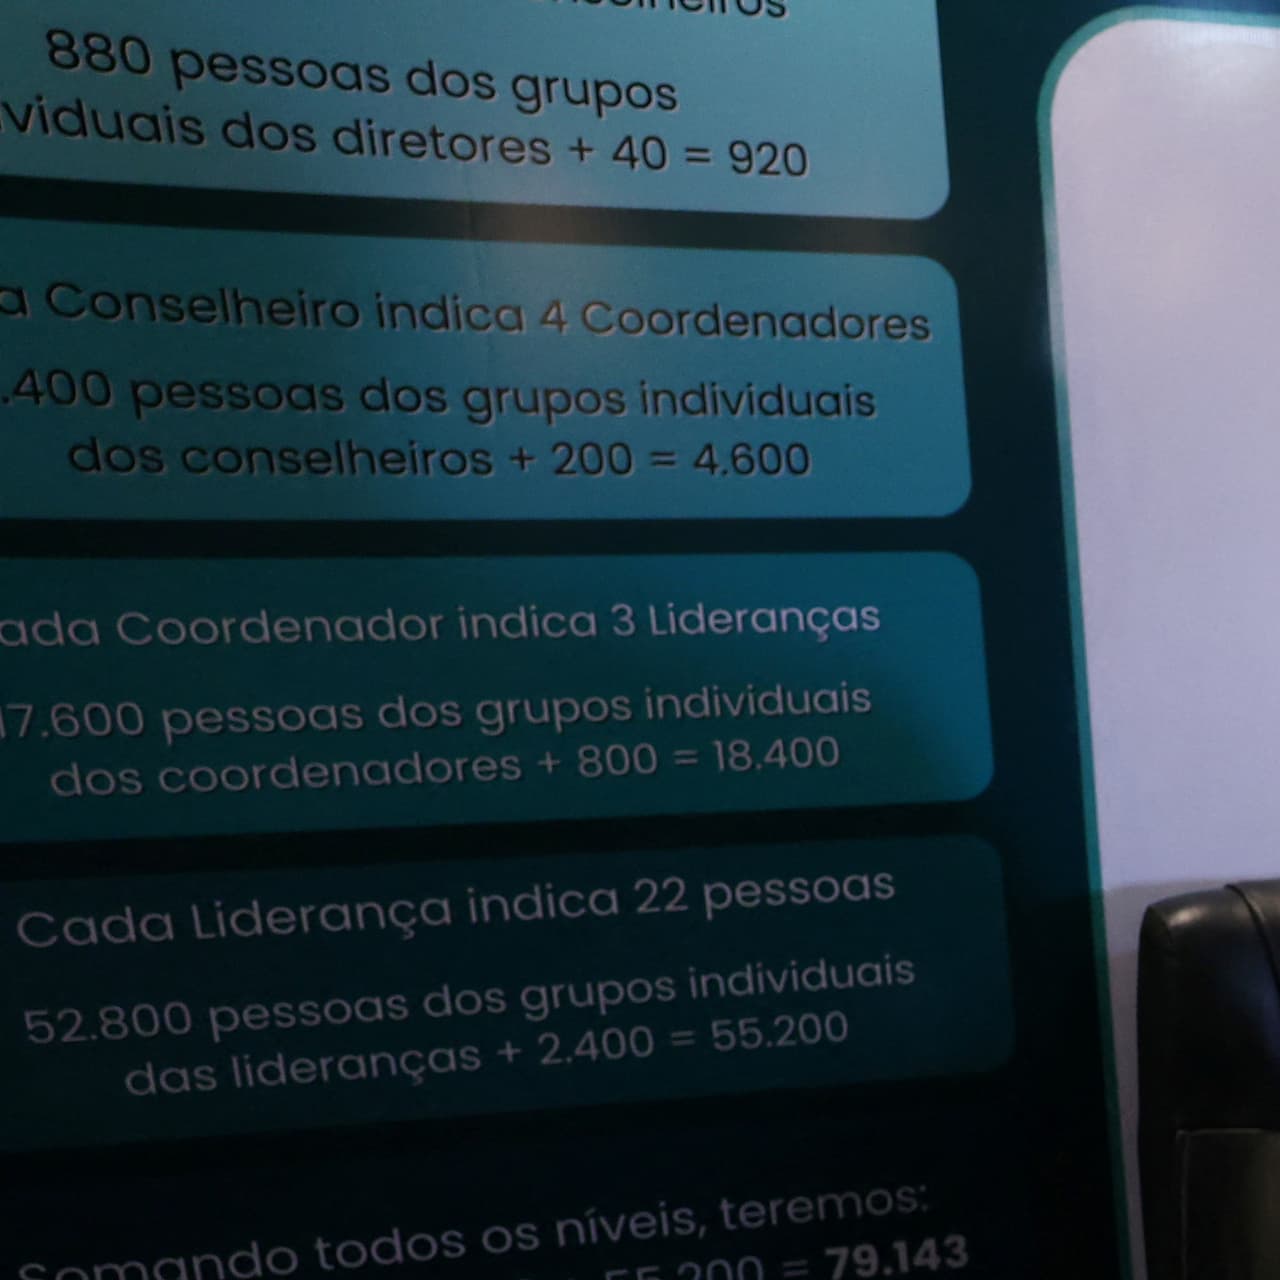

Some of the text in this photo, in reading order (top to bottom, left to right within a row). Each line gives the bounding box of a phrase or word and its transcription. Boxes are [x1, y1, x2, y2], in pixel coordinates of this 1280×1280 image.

[46, 28, 679, 118] 880 pessoas dos grupos
[222, 111, 317, 153] dos
[333, 119, 552, 165] diretores
[569, 136, 593, 163] +
[612, 135, 667, 171] 40
[686, 146, 712, 165] =
[729, 140, 809, 177] 920
[0, 282, 931, 341] a Conselheiro indica 4 Coordenadores
[131, 380, 346, 420] pessoas
[360, 377, 449, 414] dos
[464, 384, 627, 426] grupos
[640, 381, 876, 418] individuais
[68, 437, 811, 478] dos conselheiros + 200 = 4.600
[0, 603, 881, 647] ada Coordenador indica 3 Lideranças
[162, 702, 364, 746] pessoas
[378, 695, 463, 730] dos
[476, 696, 632, 736] grupos
[645, 681, 872, 720] individuais
[50, 736, 840, 797] dos coordenadores + 800 = 18.400
[17, 871, 896, 948] Cada Liderança indica 22 pessoas
[24, 953, 916, 1044] 52.800 pessoas dos grupos individuais
[125, 1010, 849, 1097] das lideranças + 2.400 = 55.200
[314, 1228, 466, 1271] todos
[481, 1222, 541, 1256] os
[555, 1202, 706, 1248] níveis,
[719, 1183, 930, 1231] teremos:
[781, 1258, 810, 1280] =
